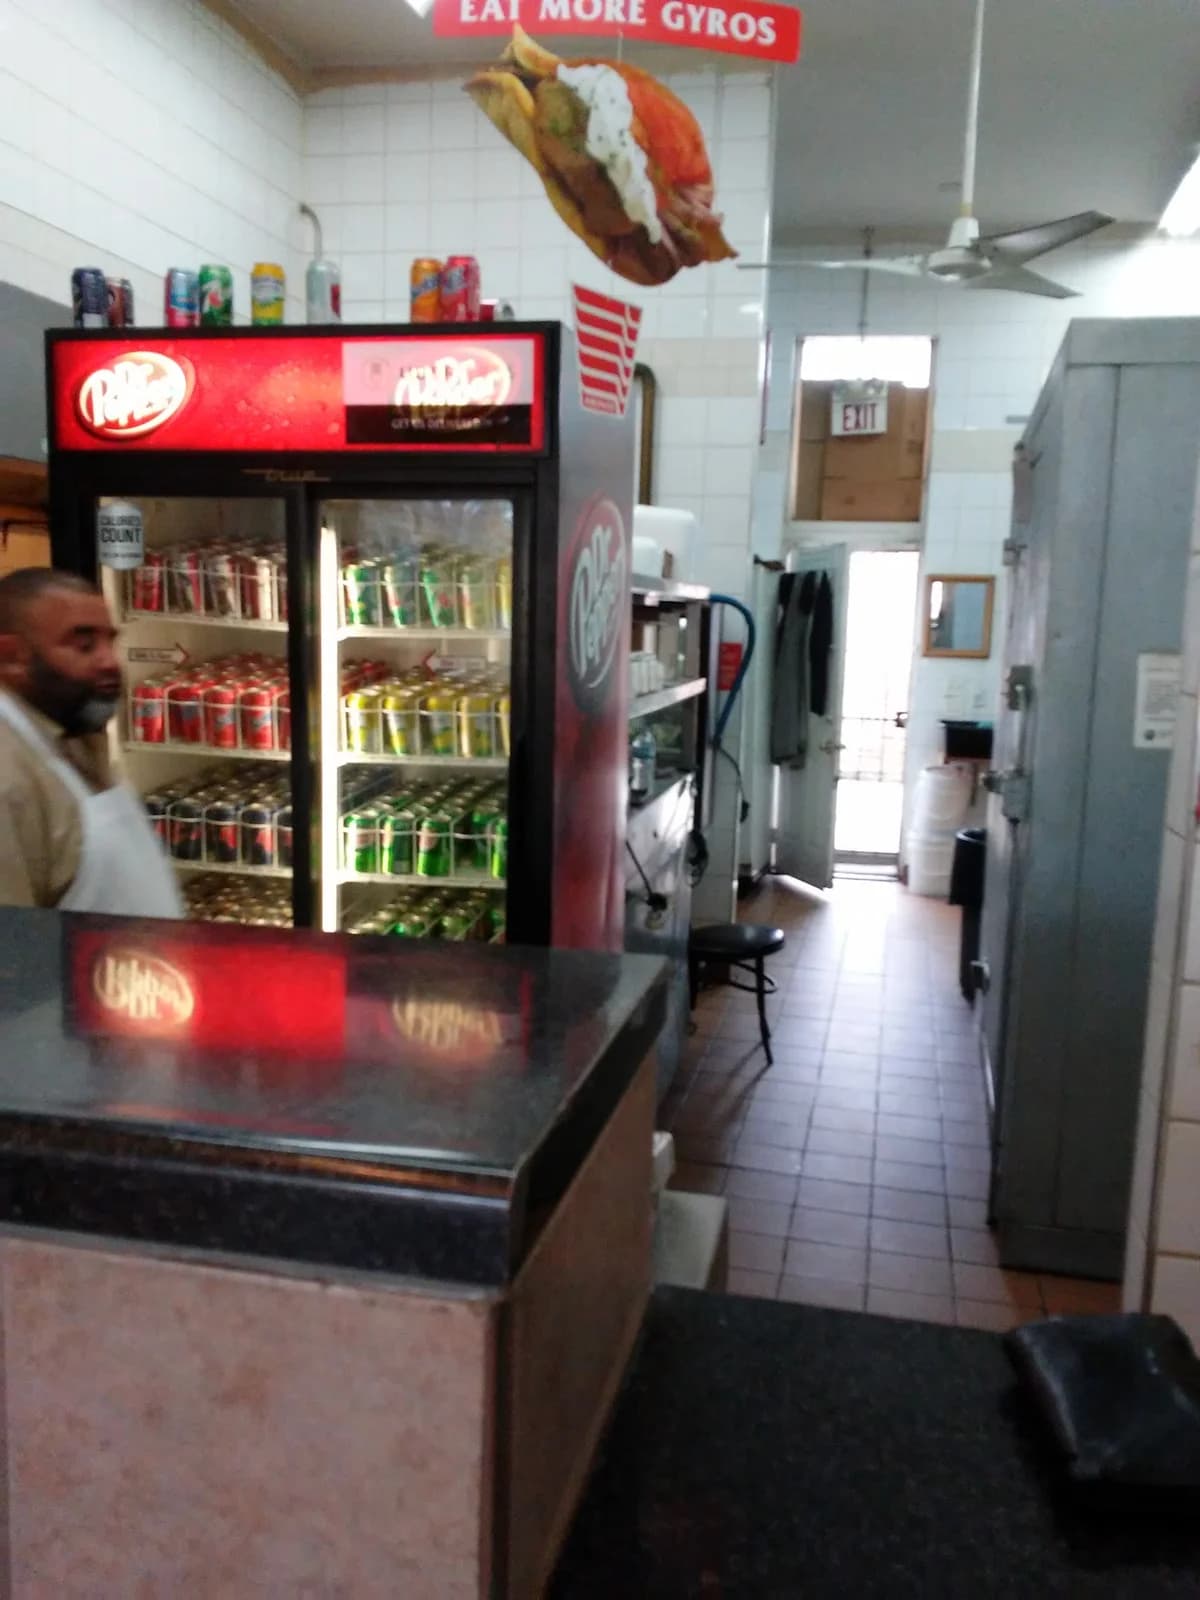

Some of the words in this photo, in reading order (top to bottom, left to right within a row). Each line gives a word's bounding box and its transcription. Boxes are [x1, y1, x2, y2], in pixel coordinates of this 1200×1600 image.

[459, 0, 520, 22] EAT
[538, 0, 647, 25] MORE
[661, 2, 777, 46] GYROS
[842, 402, 878, 431] EXIT
[101, 527, 142, 544] COUNT
